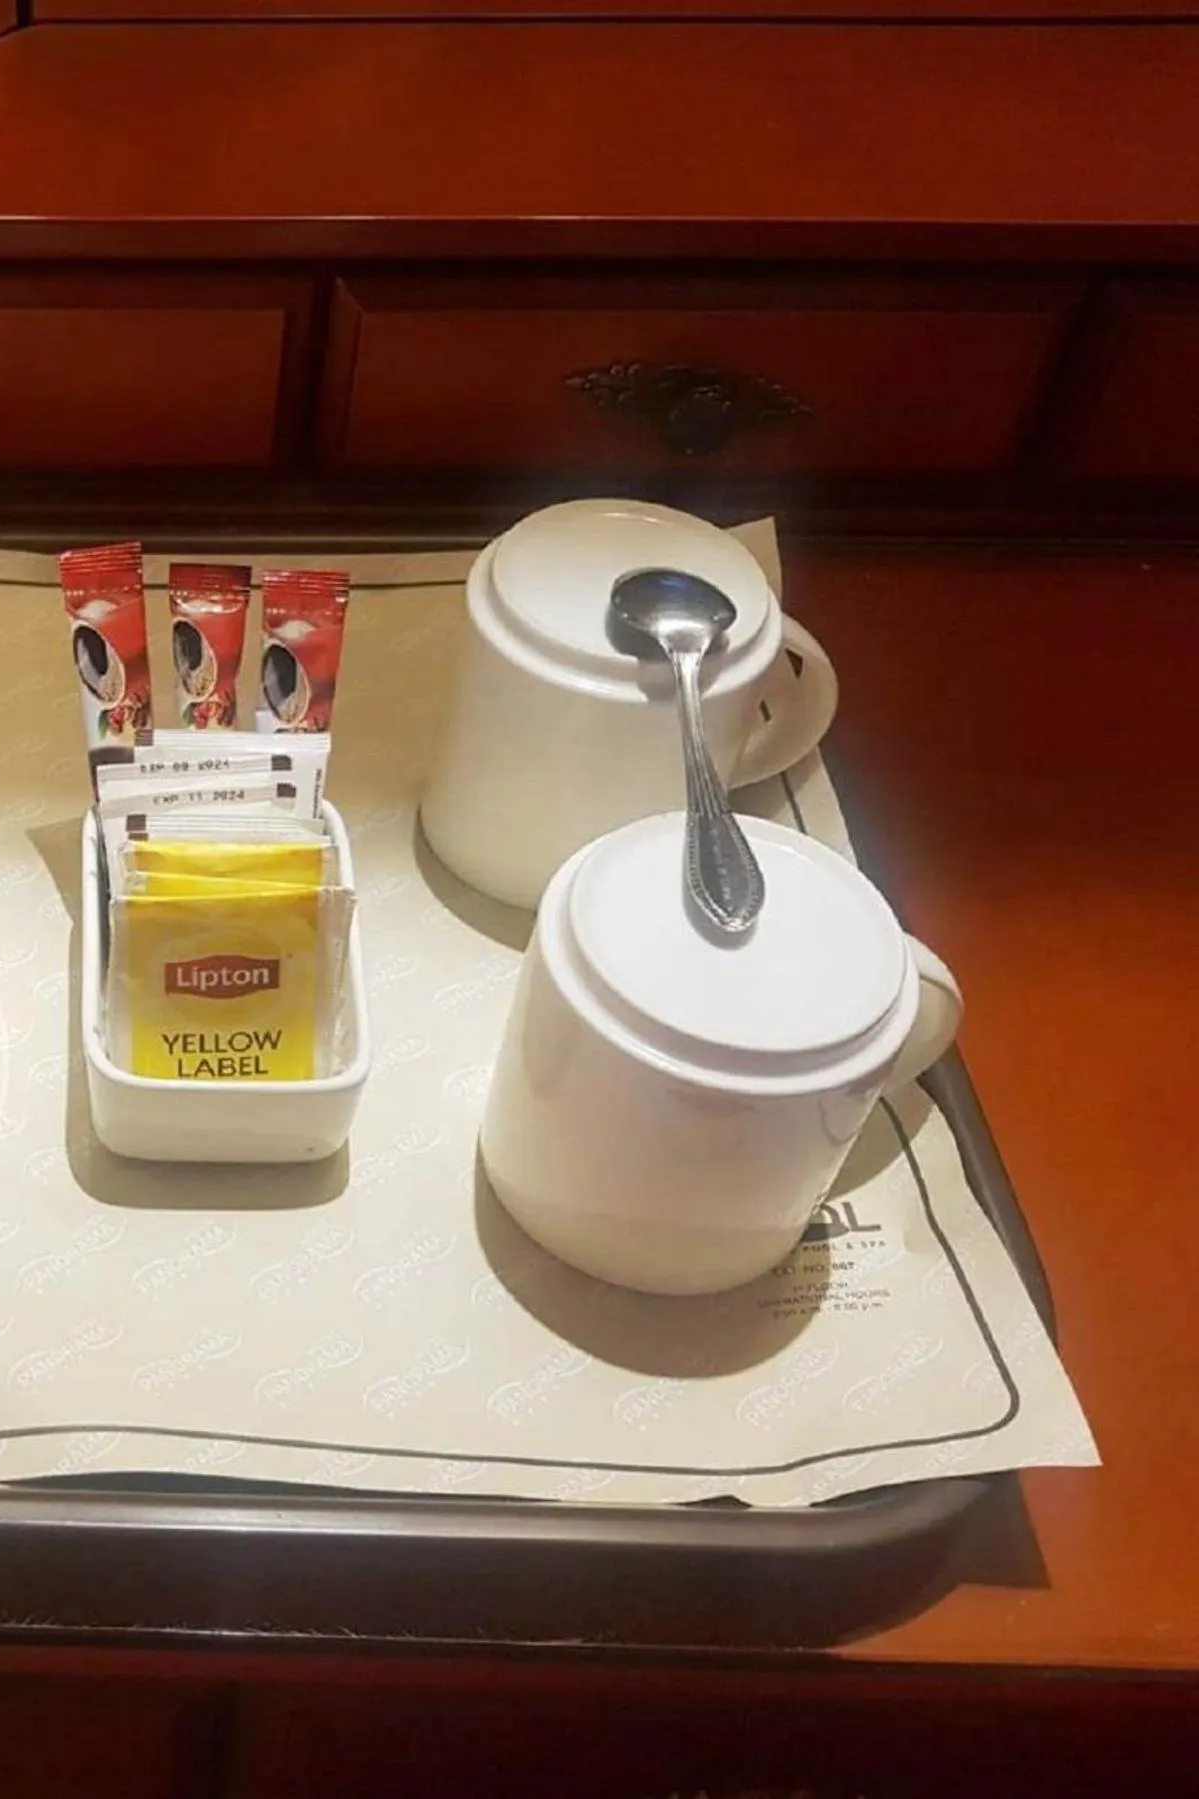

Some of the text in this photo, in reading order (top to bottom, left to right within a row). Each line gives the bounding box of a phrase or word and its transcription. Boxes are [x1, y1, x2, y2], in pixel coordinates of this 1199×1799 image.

[213, 788, 245, 802] 2024
[175, 964, 270, 991] Lipton
[161, 1029, 282, 1055] YELLOW
[177, 1056, 269, 1079] LABEL
